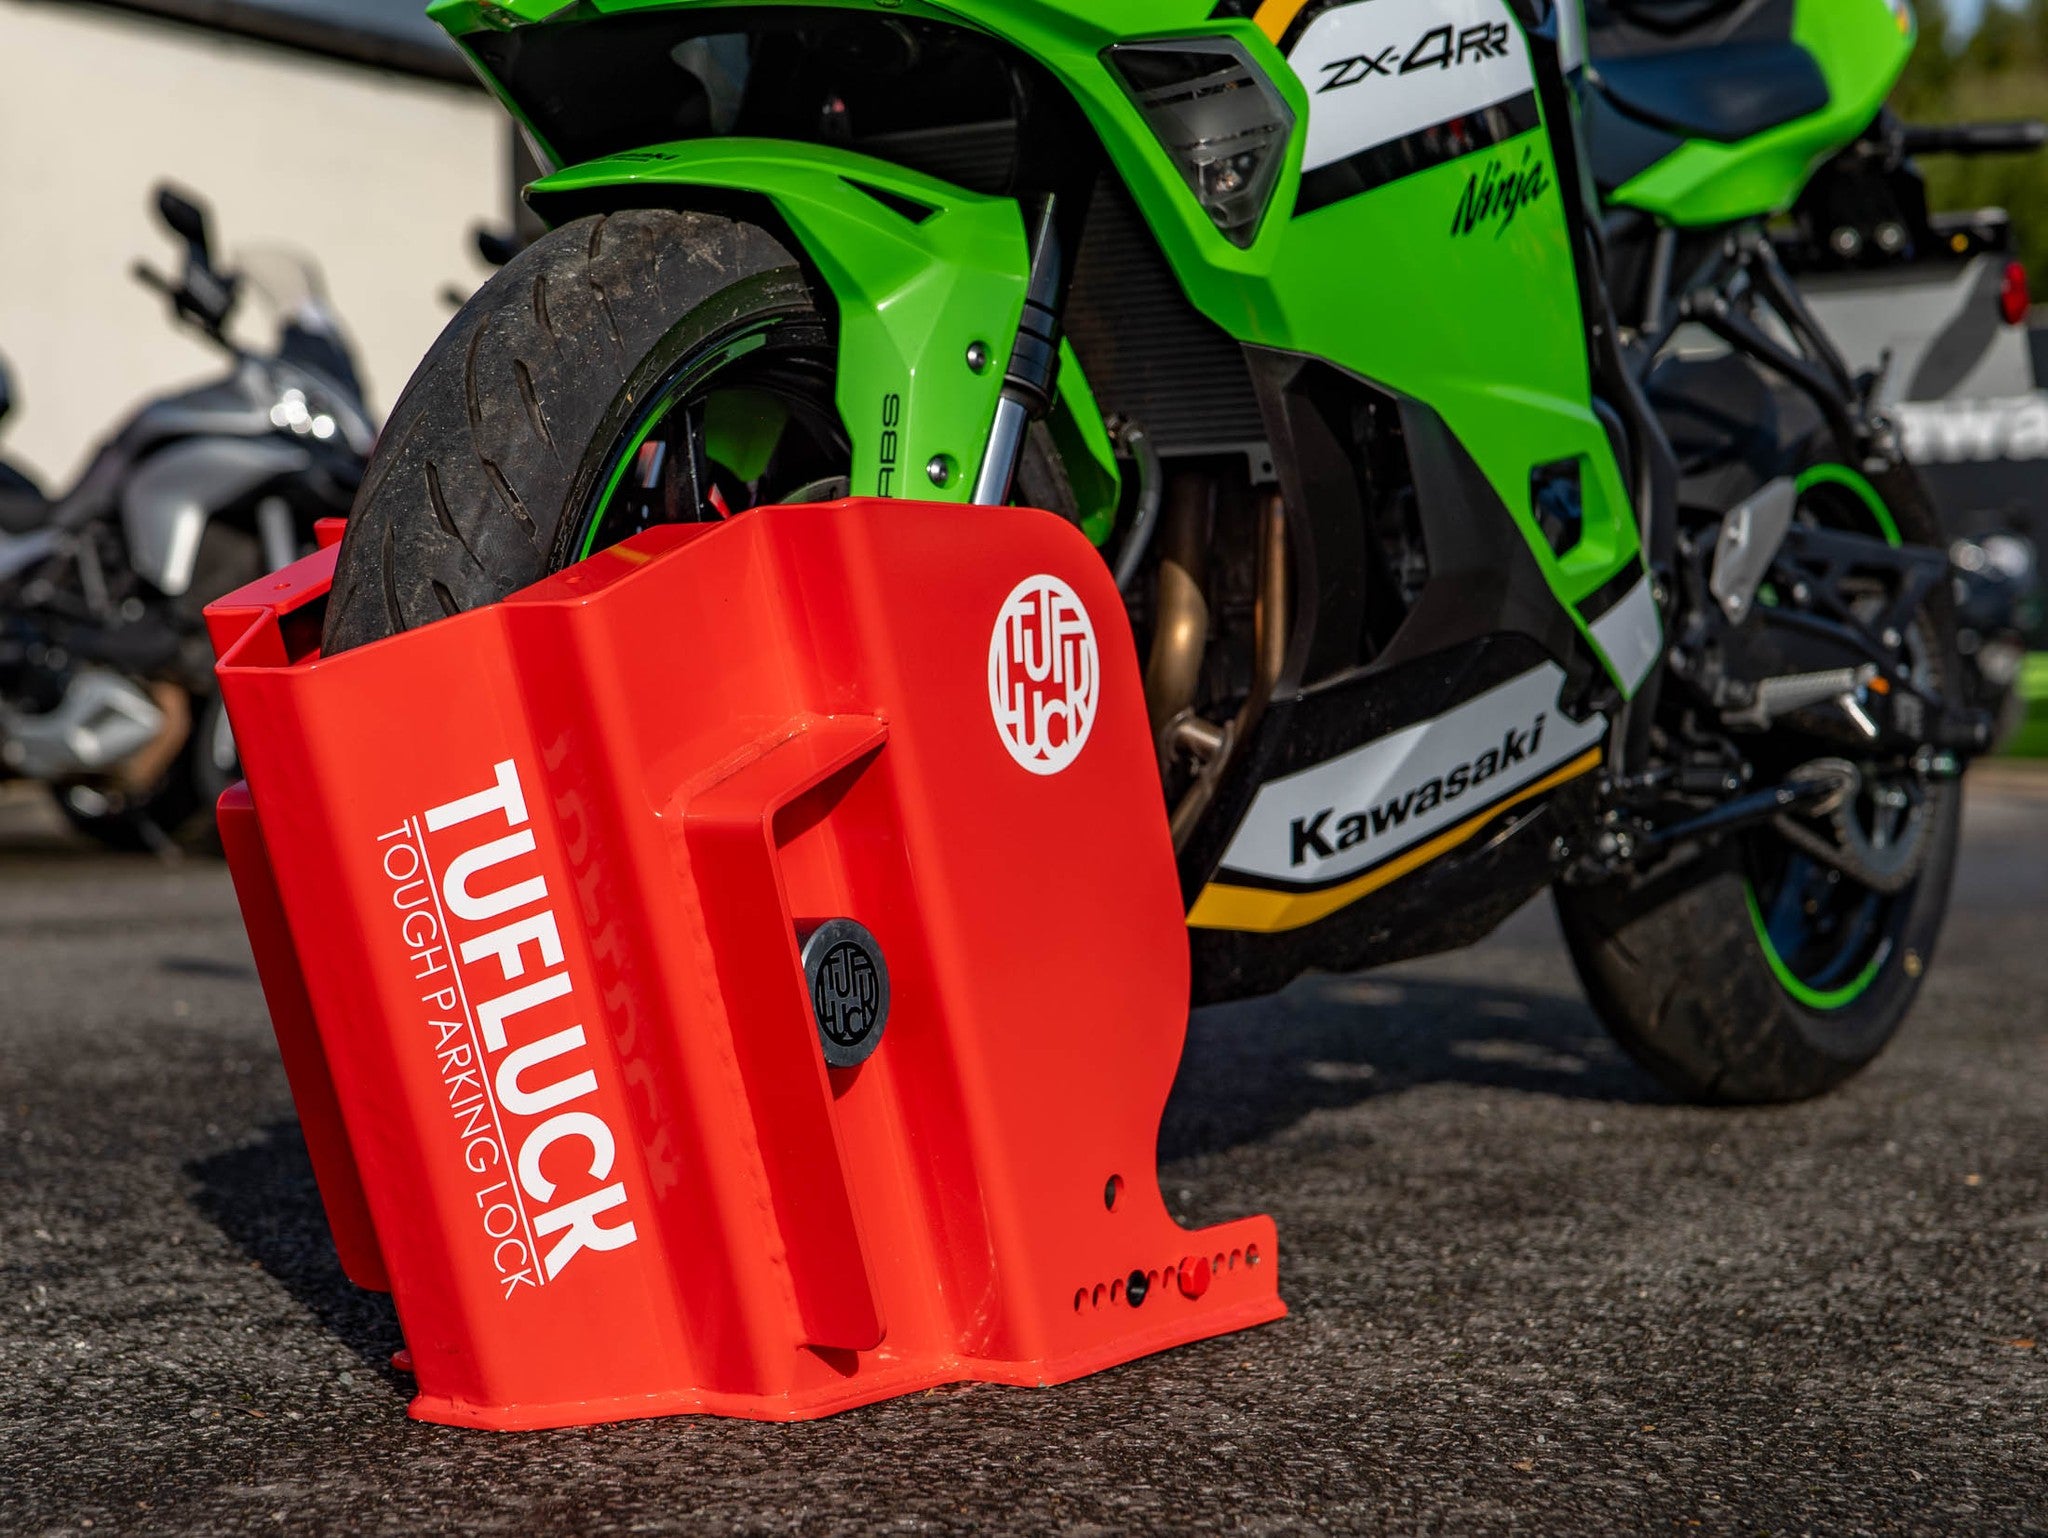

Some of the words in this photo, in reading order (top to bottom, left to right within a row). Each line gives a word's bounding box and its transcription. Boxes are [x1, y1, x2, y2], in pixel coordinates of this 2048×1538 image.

[1451, 145, 1549, 238] Ninja
[877, 394, 900, 498] ABS
[1290, 712, 1547, 866] Kawasaki
[377, 818, 448, 980] TOUGH
[421, 985, 499, 1174] PARKING
[475, 1181, 537, 1300] LOCK
[424, 758, 638, 1281] TUFLUCK
